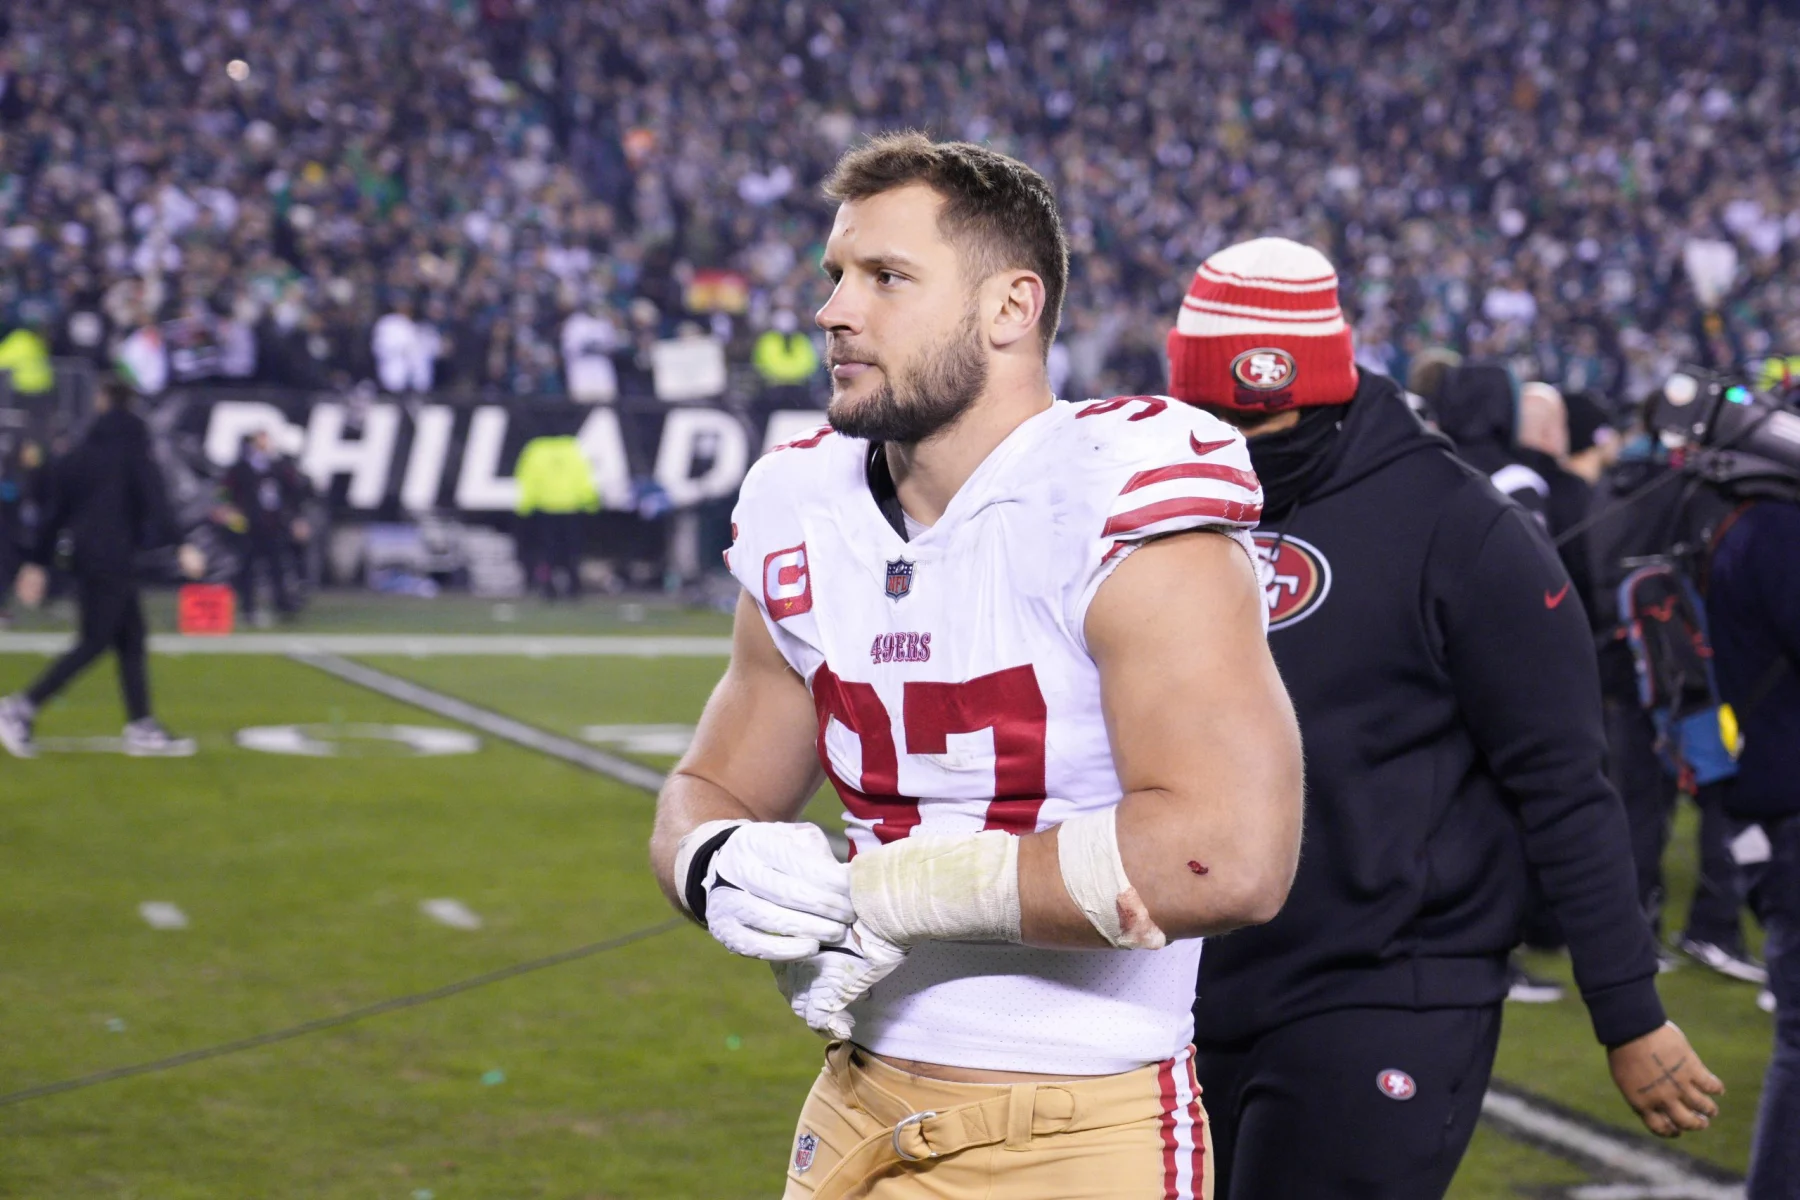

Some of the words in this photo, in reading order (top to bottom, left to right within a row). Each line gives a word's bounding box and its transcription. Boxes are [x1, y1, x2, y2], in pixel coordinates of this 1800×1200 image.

[766, 549, 807, 600] C
[888, 575, 908, 593] NFL
[870, 631, 931, 664] 49ERS
[811, 662, 1047, 862] 97
